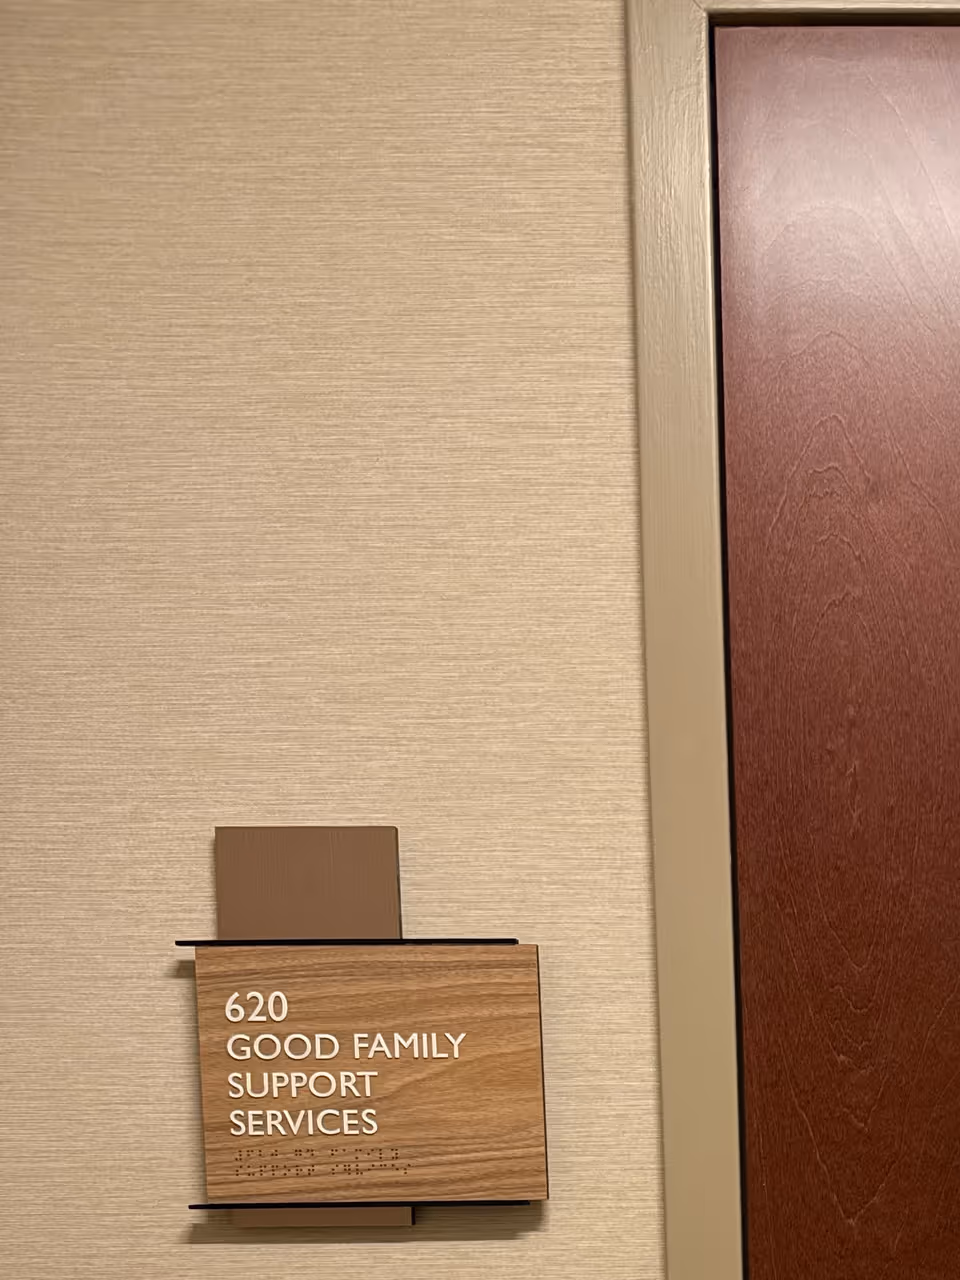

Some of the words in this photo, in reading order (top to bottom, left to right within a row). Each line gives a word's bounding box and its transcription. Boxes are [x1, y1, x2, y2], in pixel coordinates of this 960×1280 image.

[226, 991, 287, 1021] 620
[227, 1034, 339, 1059] GOOD
[354, 1033, 465, 1058] FAMILY
[228, 1072, 377, 1097] SUPPORT
[230, 1109, 377, 1135] SERVICES
